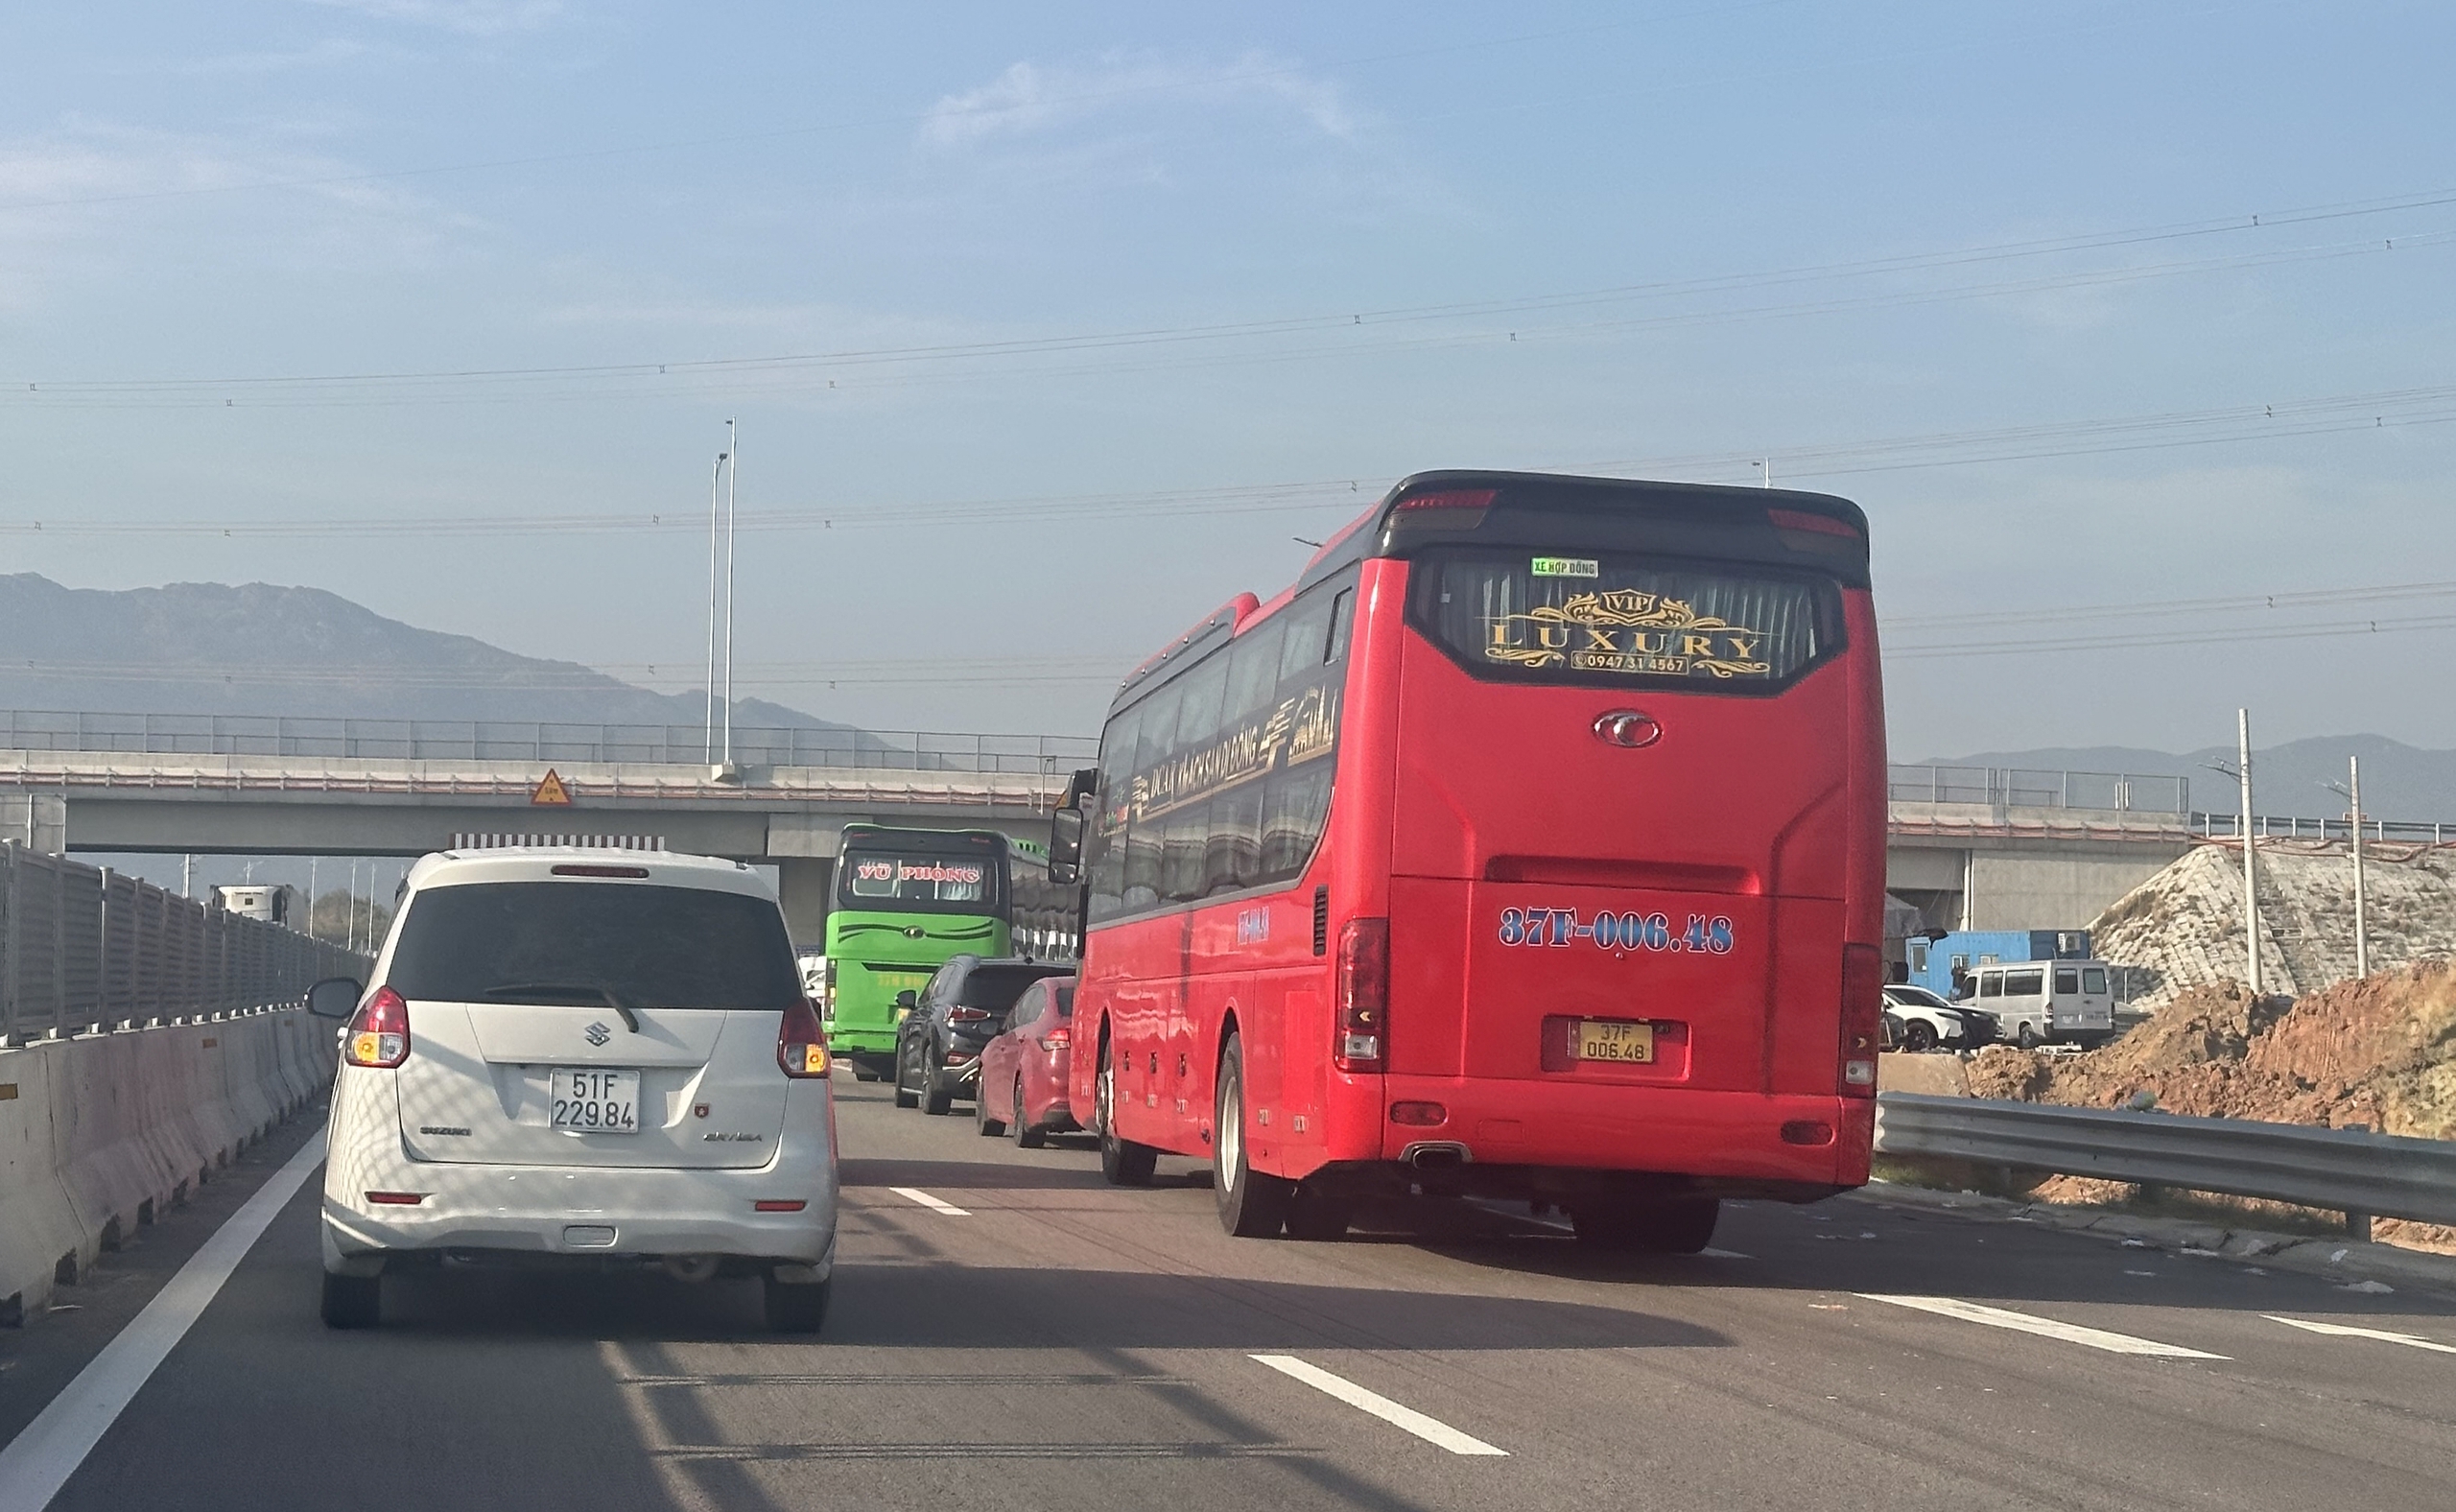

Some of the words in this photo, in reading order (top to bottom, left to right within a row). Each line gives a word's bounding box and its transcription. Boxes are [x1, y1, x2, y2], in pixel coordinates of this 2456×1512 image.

[1534, 561, 1547, 572] XE
[1609, 595, 1649, 612] VIP
[1490, 624, 1760, 659] LUXURY
[1587, 654, 1622, 670] 0947
[1626, 656, 1644, 670] 31
[1648, 658, 1684, 672] 4567
[1499, 906, 1734, 955] 37F-006.48
[1600, 1024, 1632, 1041] 37F
[1587, 1041, 1644, 1060] 006.48
[573, 1072, 618, 1099] 51F
[555, 1099, 634, 1127] 229.84
[419, 1126, 472, 1137] SUZUKI
